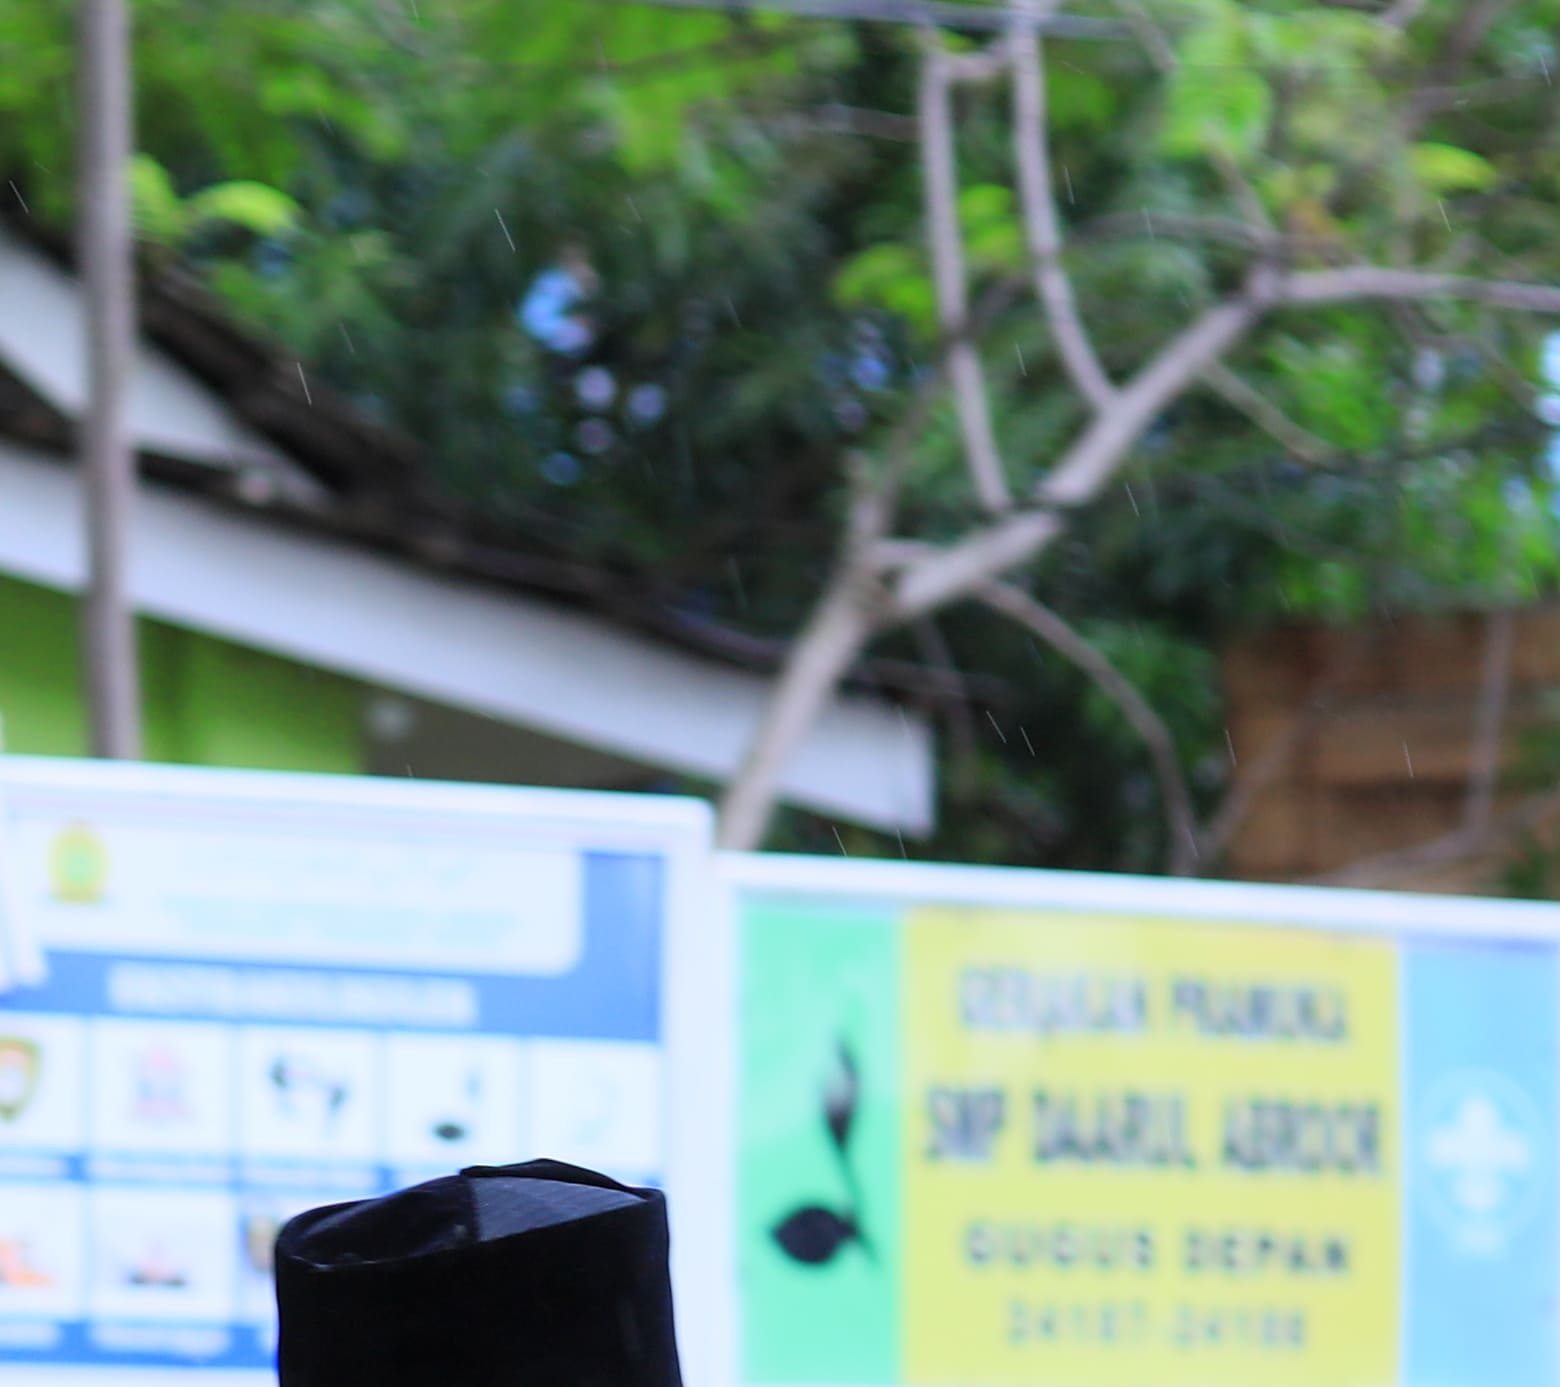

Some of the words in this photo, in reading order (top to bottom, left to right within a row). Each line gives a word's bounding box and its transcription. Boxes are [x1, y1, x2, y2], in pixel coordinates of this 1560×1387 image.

[921, 1085, 1010, 1165] SMP
[1030, 1087, 1200, 1174] DAARUL
[963, 1220, 1154, 1275] GUGUS
[1182, 1224, 1350, 1278] DEPAN
